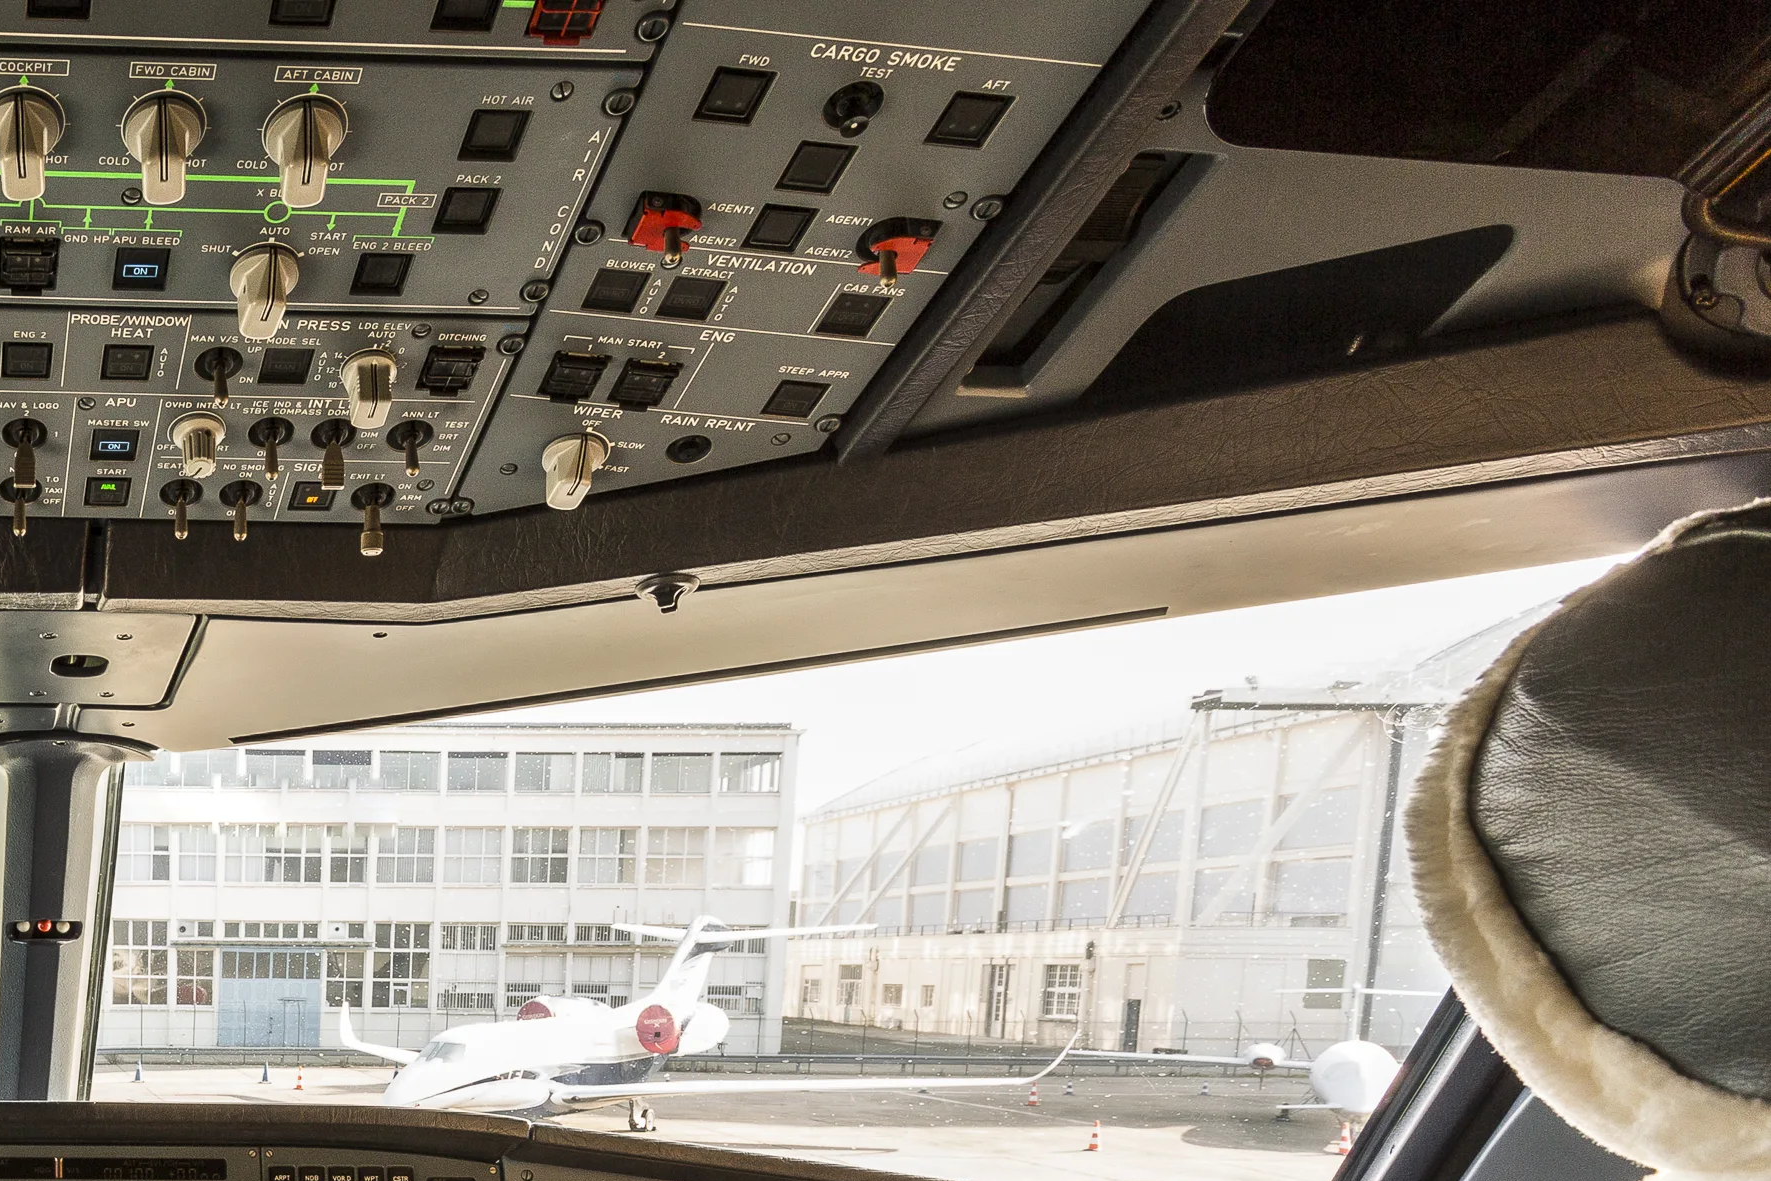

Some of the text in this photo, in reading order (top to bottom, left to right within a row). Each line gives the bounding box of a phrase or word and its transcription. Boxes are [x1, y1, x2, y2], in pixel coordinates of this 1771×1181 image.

[810, 42, 962, 72] CARGO SMOKE
[0, 61, 53, 73] COCKPIT
[135, 65, 211, 78] FWD CABIN
[283, 70, 355, 81] AFT CABIN
[860, 68, 893, 79] TEST
[482, 95, 534, 106] HOT AIR
[707, 202, 755, 216] AGENT1
[5, 225, 57, 235] RAM AIR
[308, 246, 340, 256] OPEN
[804, 246, 853, 259] AGENT2
[606, 260, 655, 271] BLOWER
[707, 254, 817, 276] VENTILATION
[682, 268, 734, 280] EXTRACT
[71, 314, 189, 327] PROBE/WINDOW
[297, 320, 351, 331] PRESS
[111, 327, 154, 338] HEAT
[439, 333, 486, 342] DITCHING
[598, 335, 663, 350] MAN START
[779, 366, 849, 379] STEEP APPR
[105, 398, 136, 408] APU
[573, 406, 623, 419] WIPER
[88, 419, 149, 427] MASTER SW
[660, 414, 755, 431] RAIN RPLNT
[96, 468, 127, 476] START
